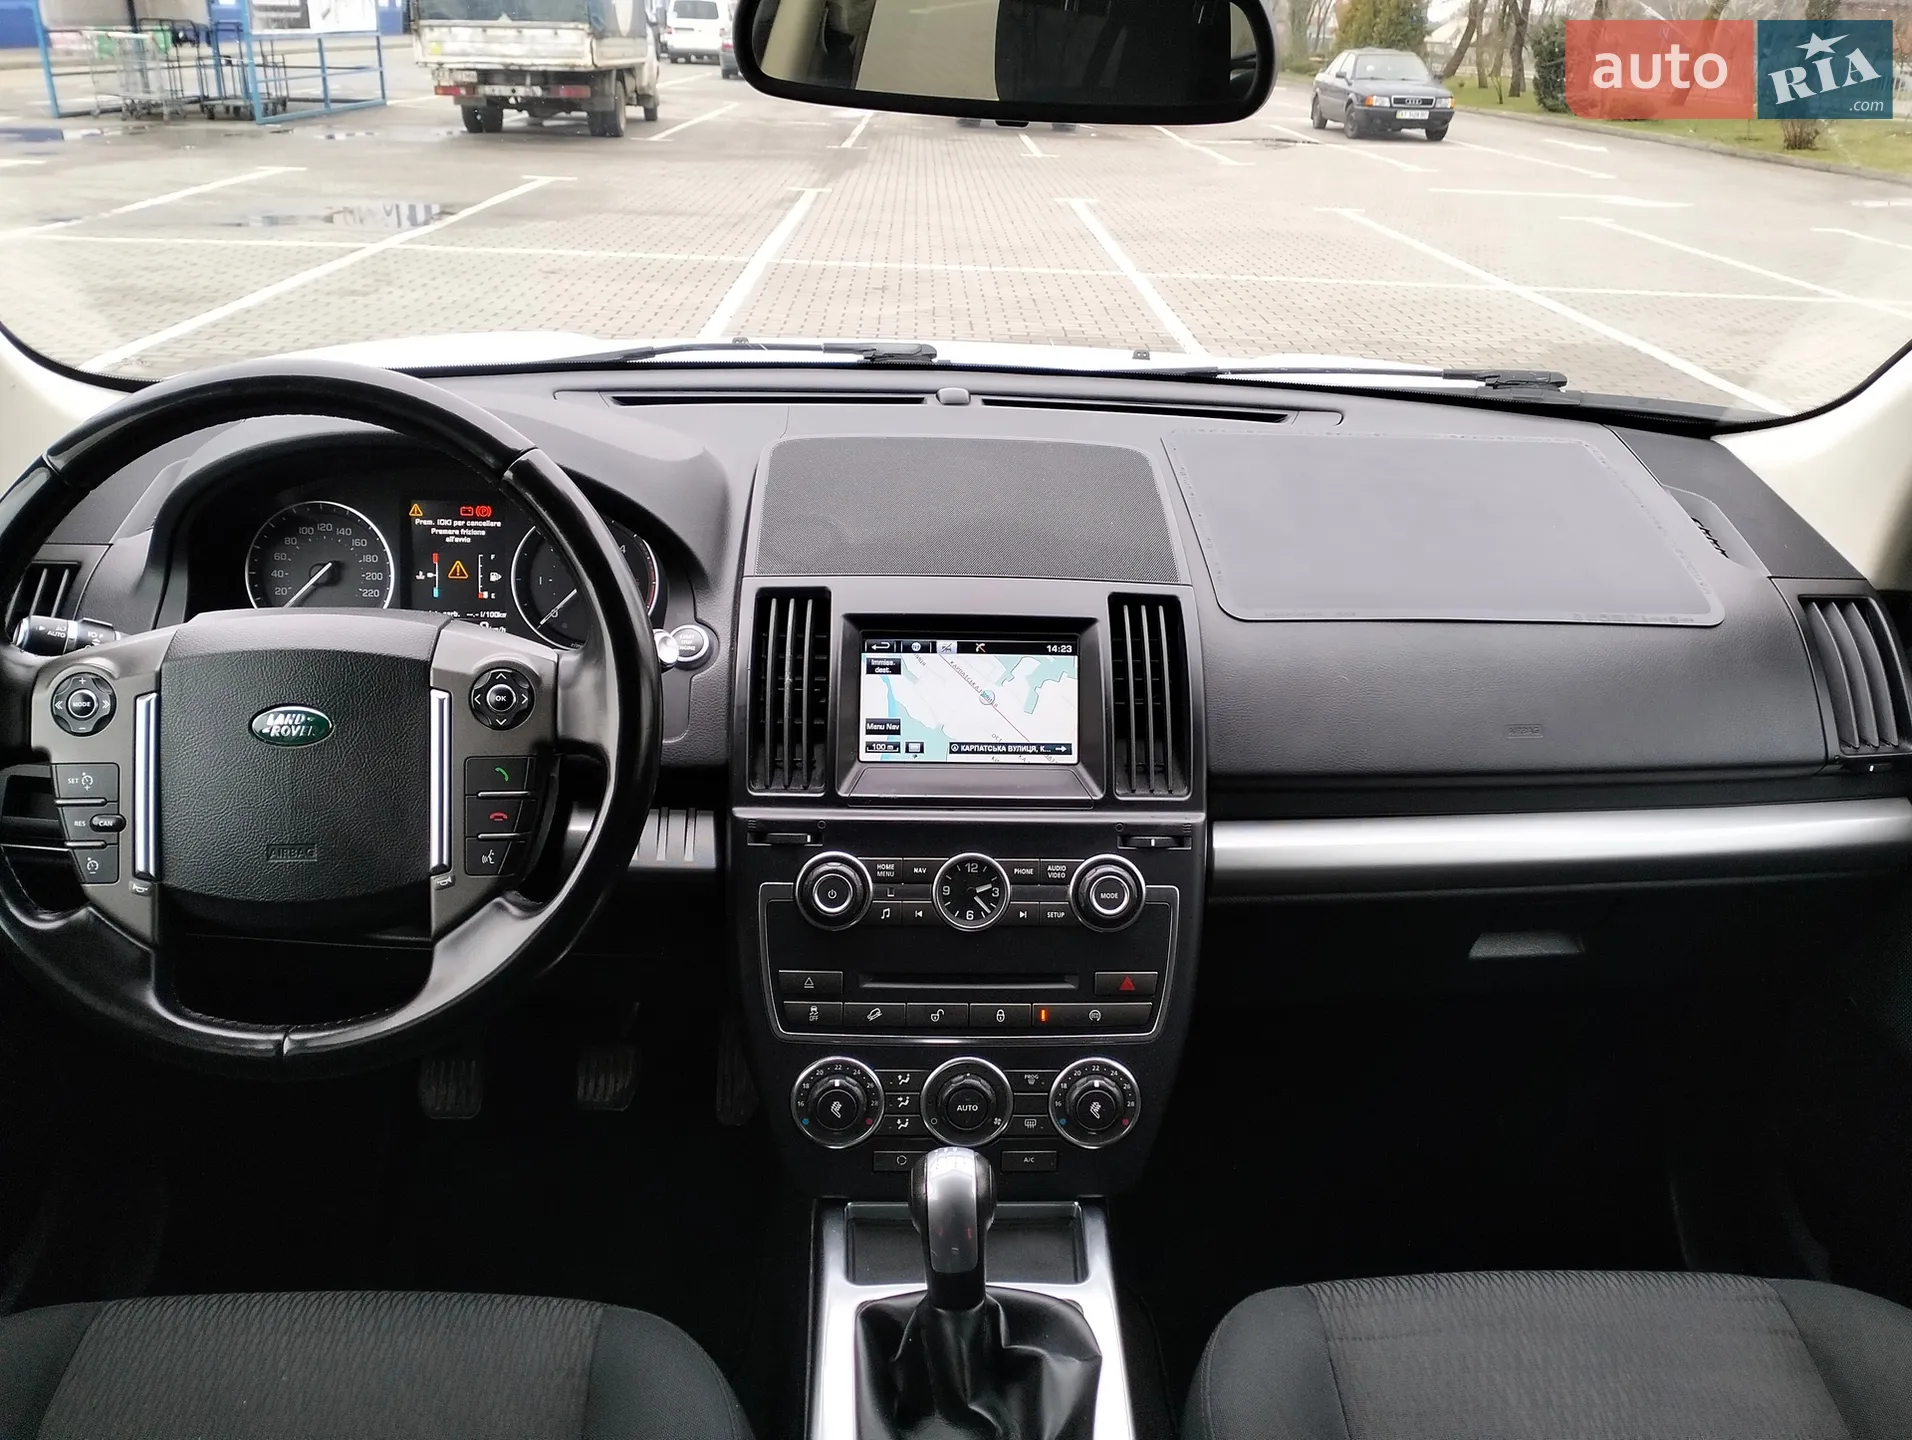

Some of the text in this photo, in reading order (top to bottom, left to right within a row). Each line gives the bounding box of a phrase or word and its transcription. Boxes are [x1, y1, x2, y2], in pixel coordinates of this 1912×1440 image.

[414, 518, 435, 526] Prem.
[453, 519, 466, 527] per
[466, 519, 502, 527] cancellare
[299, 526, 315, 535] 100
[317, 523, 333, 532] 120
[336, 527, 352, 536] 140
[430, 527, 486, 536] Premere frizione
[284, 537, 298, 545] 80
[351, 538, 368, 547] 160
[273, 552, 287, 561] 60
[362, 554, 379, 563] 180
[270, 570, 284, 578] 40
[365, 572, 383, 581] 200
[274, 587, 288, 596] 20
[361, 589, 380, 598] 220
[47, 630, 67, 639] AUTO
[1046, 645, 1073, 653] 14:23
[72, 700, 91, 708] MODE
[266, 713, 307, 726] LAND
[960, 745, 1007, 753] КАРПАТСЬКА
[1008, 745, 1039, 753] ВУЛИЦЯ,
[964, 862, 979, 873] 12
[942, 885, 951, 896] 9
[991, 887, 1000, 897] 3
[966, 910, 974, 920] 6
[956, 1104, 979, 1112] AUTO
